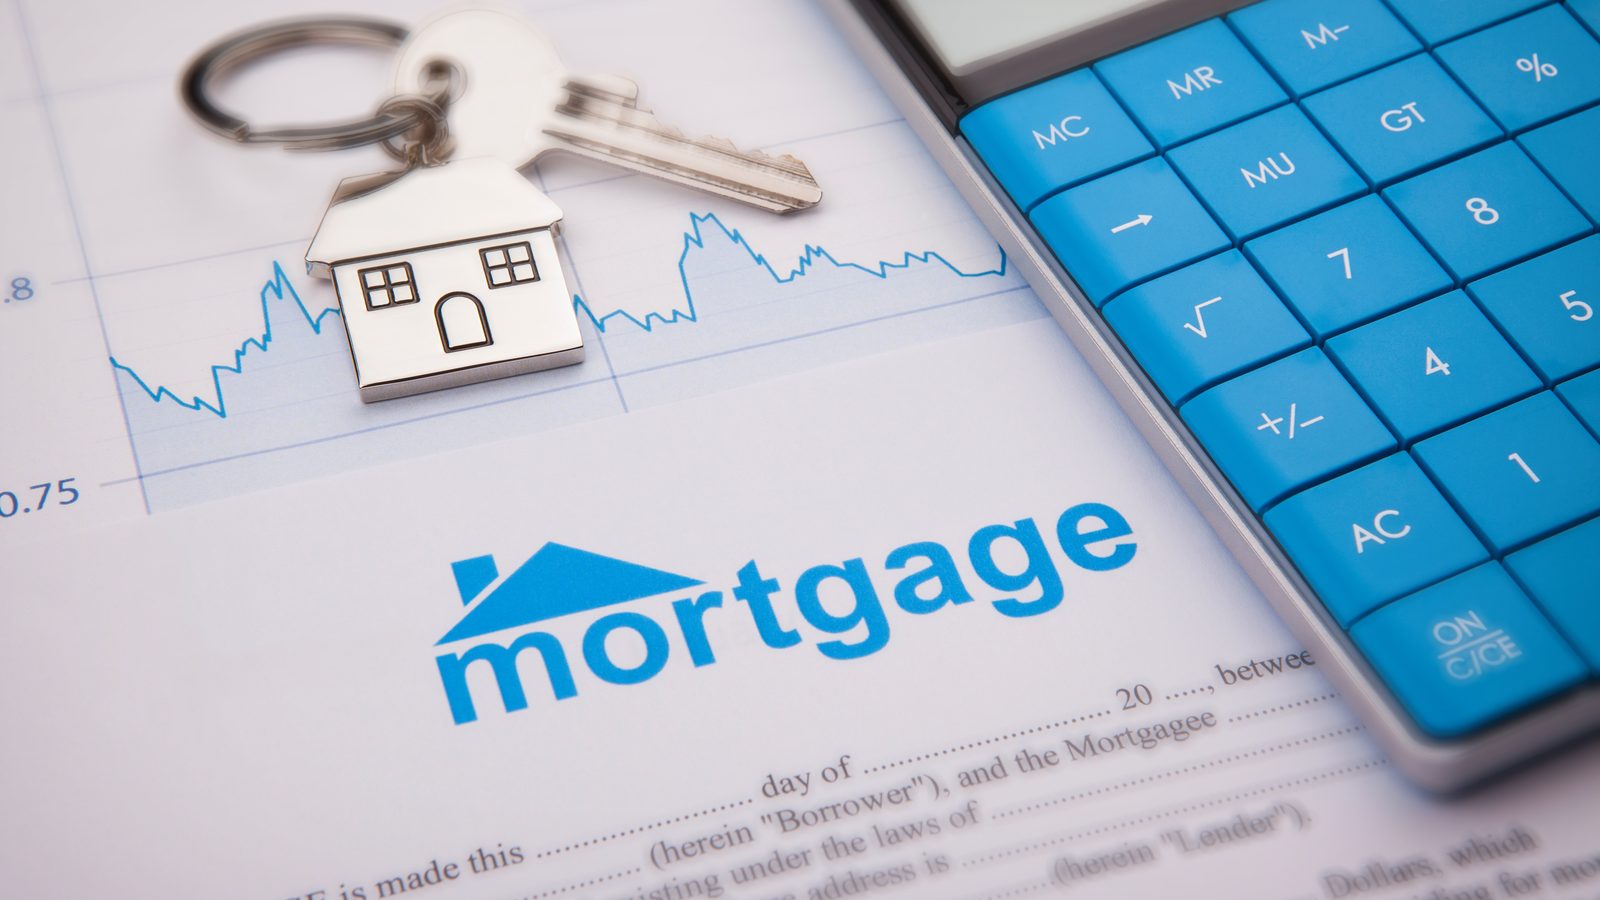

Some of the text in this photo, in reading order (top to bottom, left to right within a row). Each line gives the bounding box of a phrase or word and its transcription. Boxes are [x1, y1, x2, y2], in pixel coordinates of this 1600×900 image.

[1167, 66, 1222, 100] MR
[1516, 53, 1558, 82] %
[1032, 115, 1090, 150] MC
[1380, 102, 1426, 132] GT
[1240, 152, 1296, 189] MU
[1465, 197, 1500, 225] 8
[1327, 247, 1353, 279] 7
[1559, 289, 1594, 322] 5
[1425, 346, 1451, 376] 4
[1508, 452, 1541, 483] 1
[0, 477, 80, 518] 0.75
[1352, 510, 1411, 554] AC
[435, 502, 1138, 726] mortgage
[1432, 609, 1488, 646] ON
[1446, 635, 1522, 680] C/CE
[375, 859, 461, 899] made
[467, 842, 525, 875] this
[761, 769, 811, 799] day
[821, 754, 852, 784] of
[1115, 683, 1153, 711] 20
[649, 823, 755, 871] (herein
[958, 755, 1009, 789] and
[1014, 748, 1061, 775] the
[1063, 711, 1218, 762] Mortgagee
[729, 847, 813, 886] under
[820, 833, 867, 863] the
[873, 816, 942, 849] laws
[948, 800, 980, 830] of
[807, 859, 917, 900] address
[923, 850, 950, 876] is
[1052, 842, 1156, 887] (herein
[1322, 827, 1538, 899] Dollars, which
[1498, 870, 1543, 897] for
